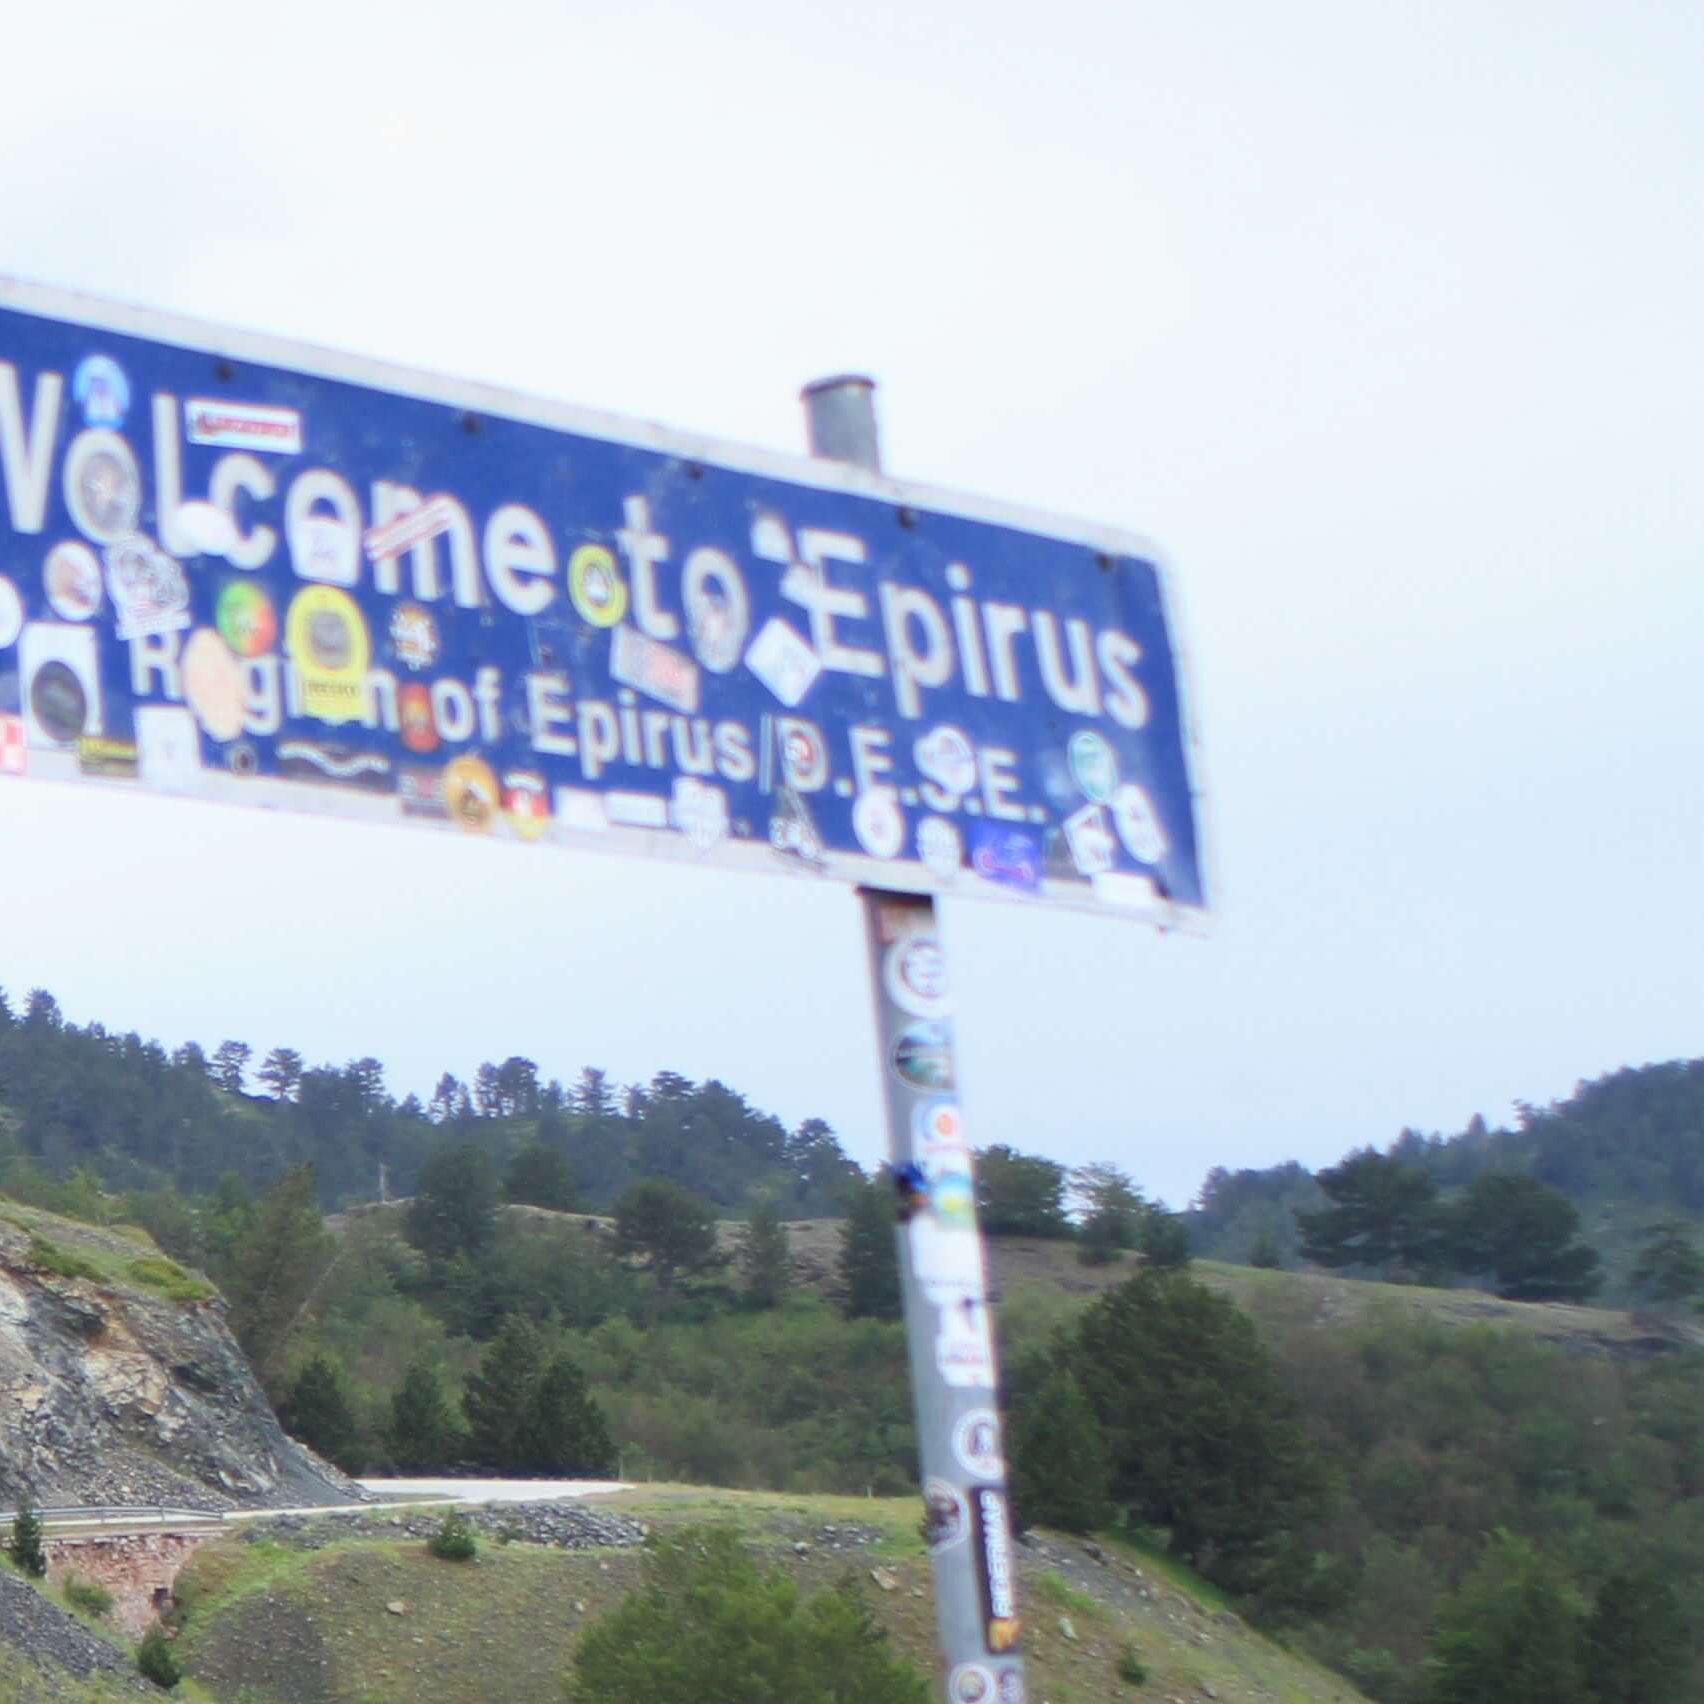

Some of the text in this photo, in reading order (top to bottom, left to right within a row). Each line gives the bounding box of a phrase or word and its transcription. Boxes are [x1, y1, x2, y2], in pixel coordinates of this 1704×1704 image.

[128, 628, 403, 737] Rgin
[428, 665, 503, 744] of
[614, 494, 751, 675] to
[794, 522, 1152, 730] Epirus
